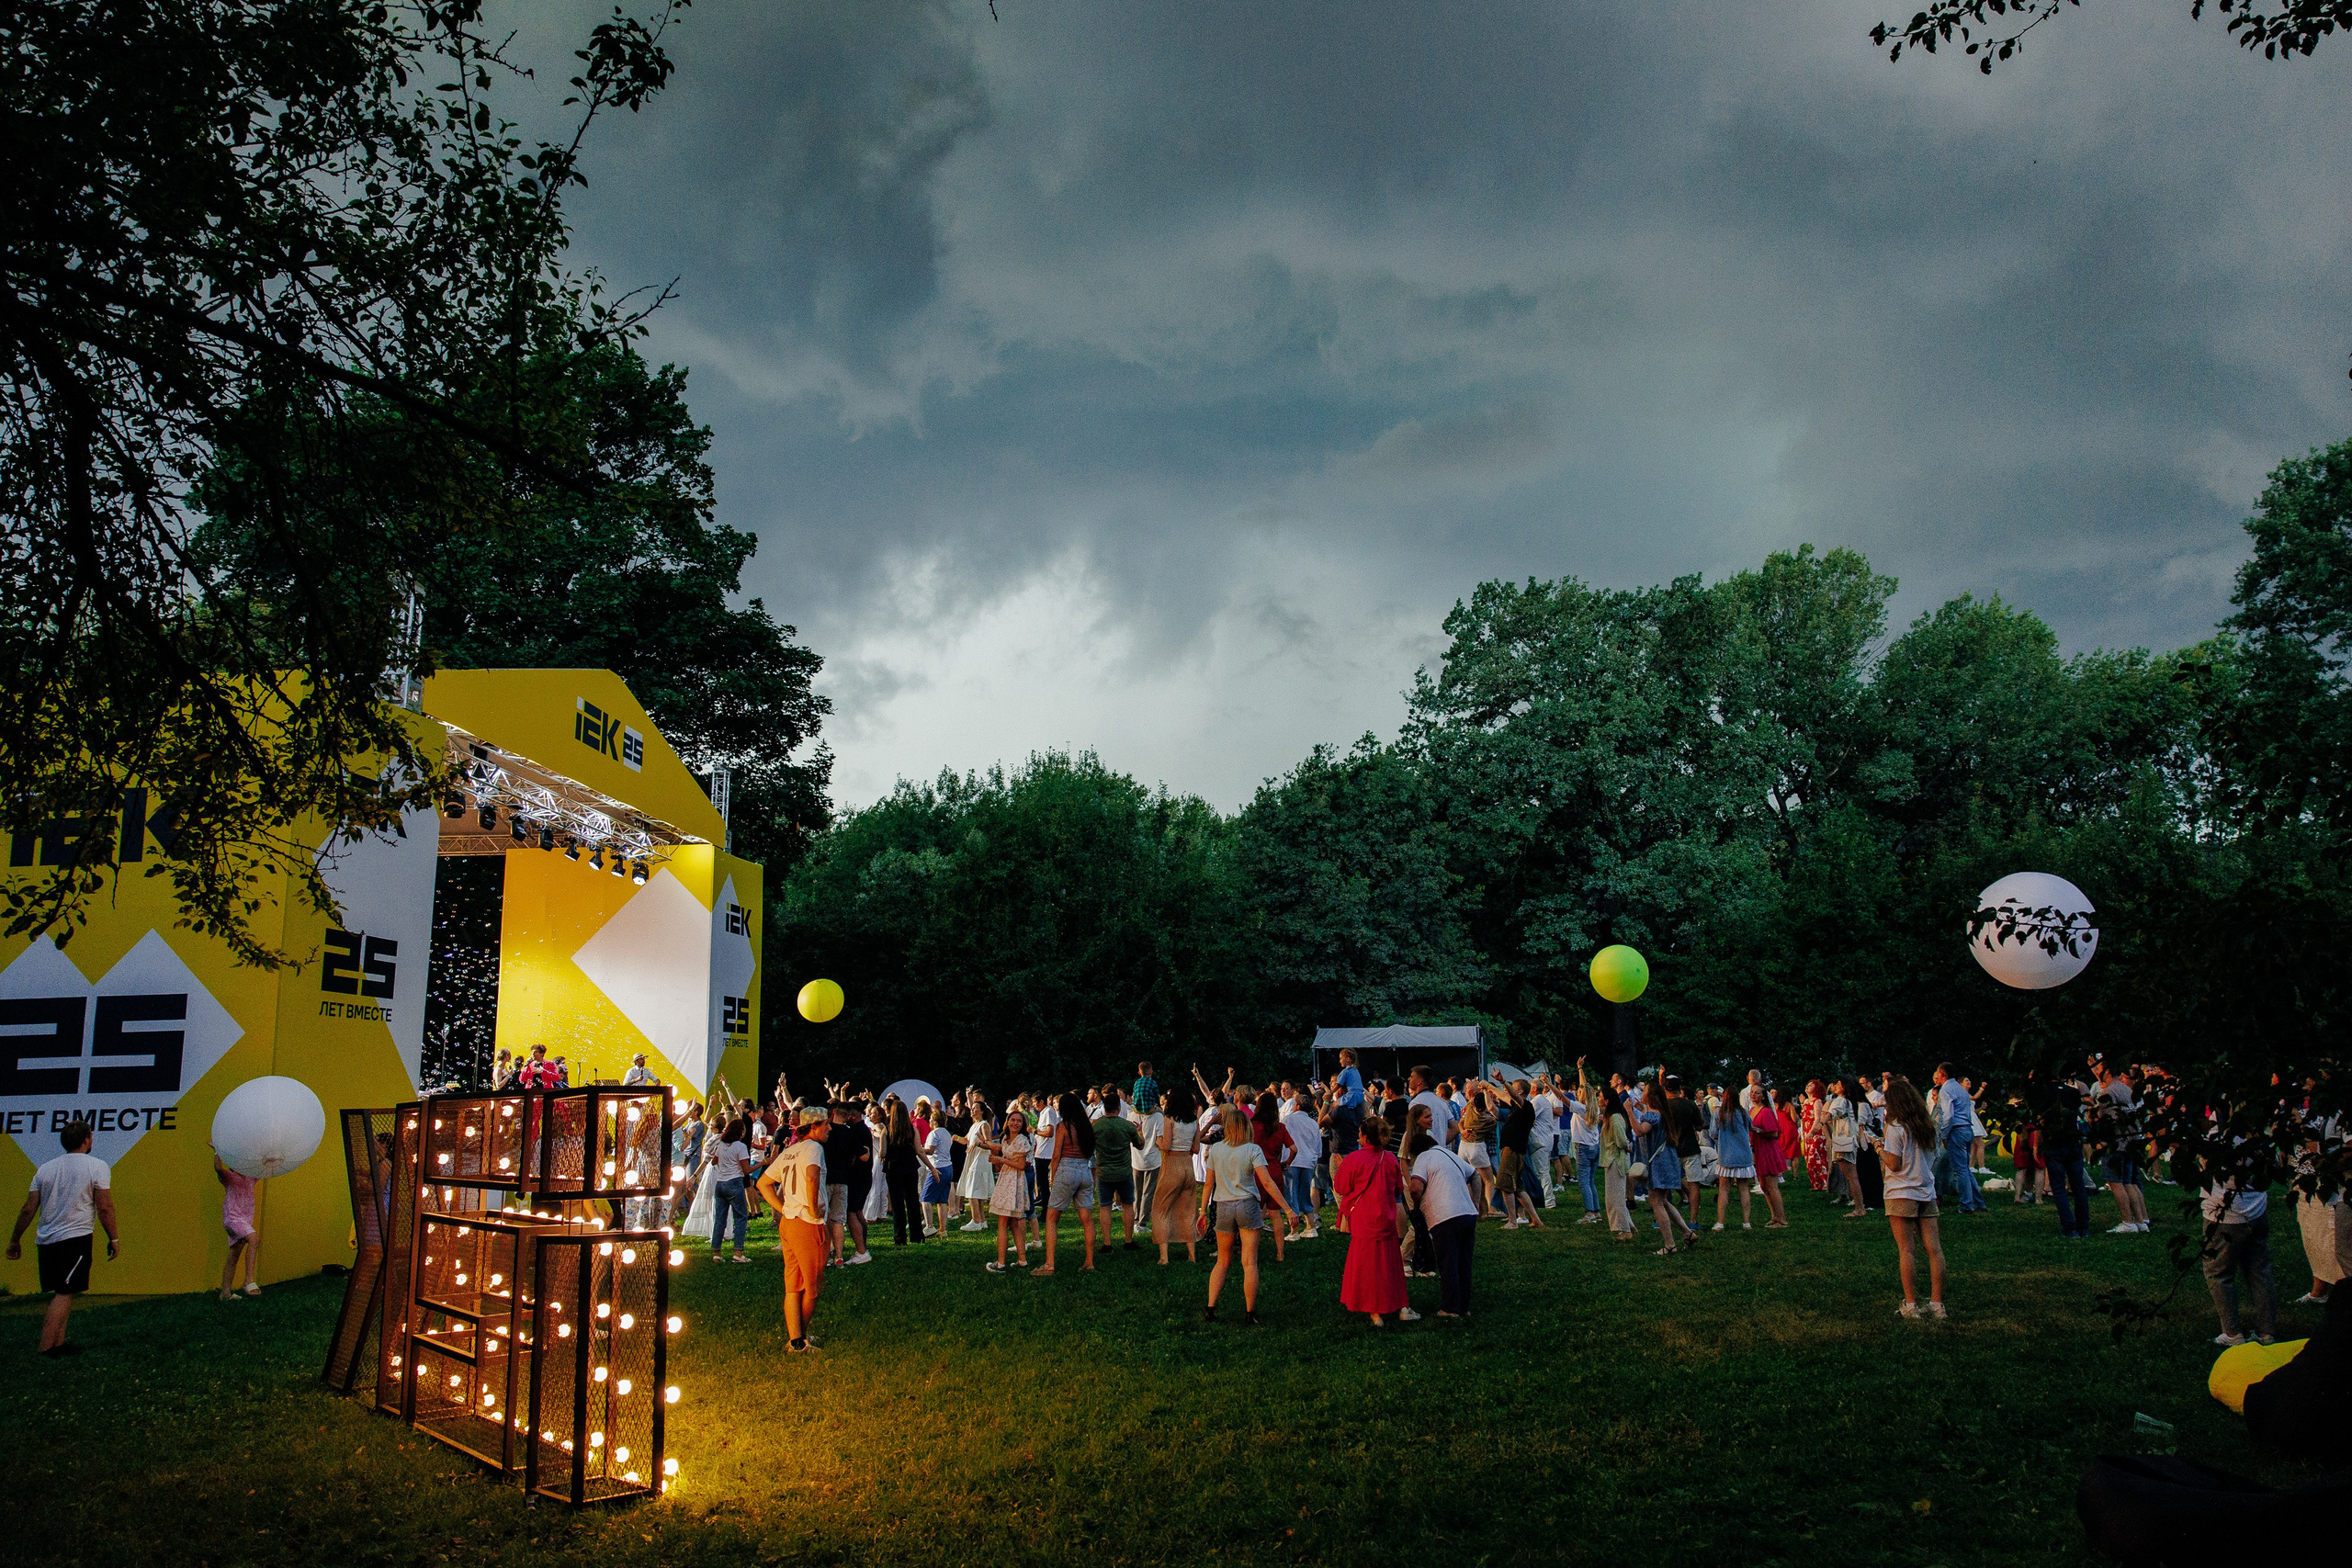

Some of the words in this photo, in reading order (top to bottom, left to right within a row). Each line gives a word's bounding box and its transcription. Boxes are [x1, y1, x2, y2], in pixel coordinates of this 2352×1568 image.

[623, 731, 644, 766] 25
[321, 927, 398, 1000] 25
[319, 1000, 345, 1018] ЛЕТ
[345, 1003, 393, 1022] ВМЕСТЕ
[723, 996, 750, 1034] 25
[0, 993, 188, 1097] 25
[0, 1111, 46, 1134] ЕТ
